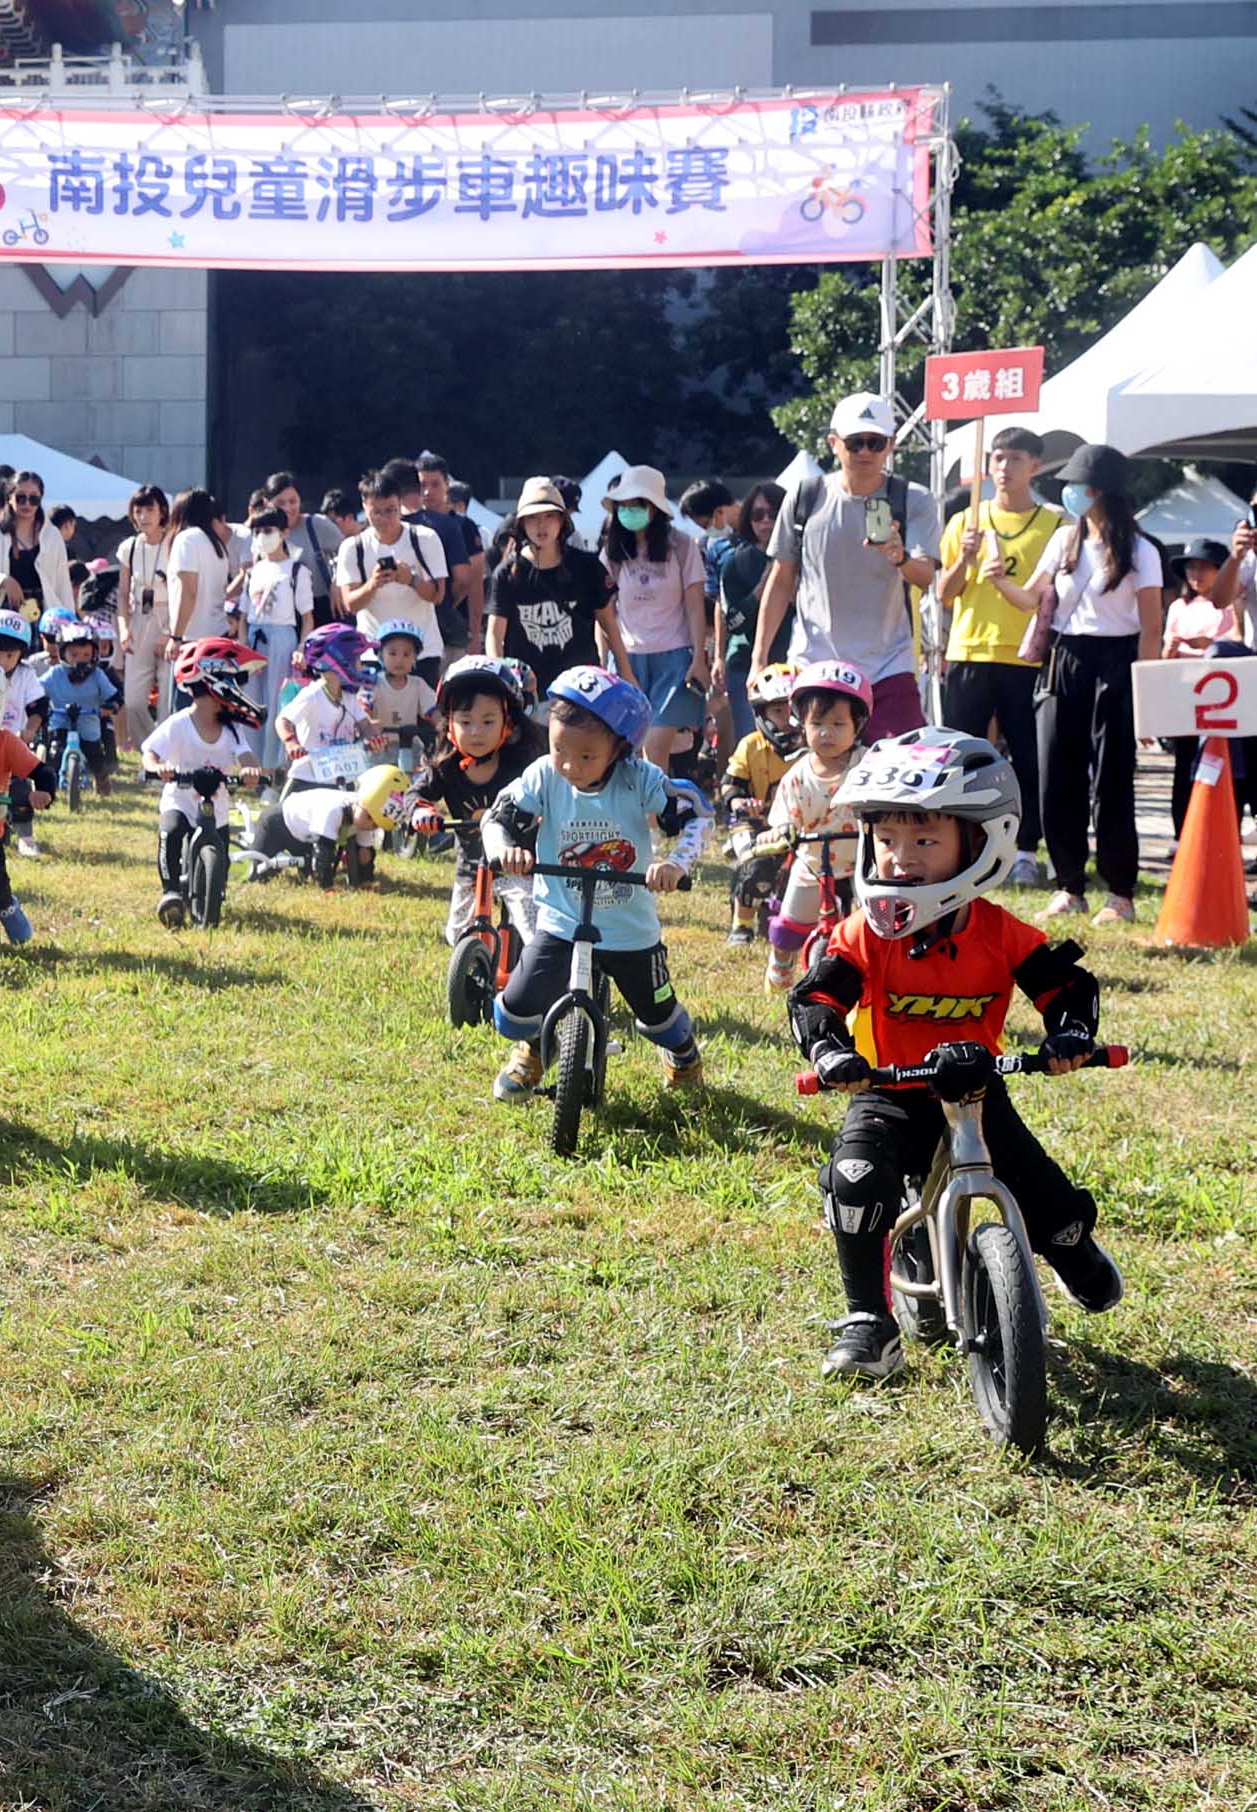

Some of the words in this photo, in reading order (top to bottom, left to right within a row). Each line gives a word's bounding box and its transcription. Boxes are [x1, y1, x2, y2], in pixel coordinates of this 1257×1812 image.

[47, 147, 730, 223] 南投兒童滑步車趣味賽
[941, 367, 1024, 401] 3歲組
[1193, 670, 1239, 730] 2
